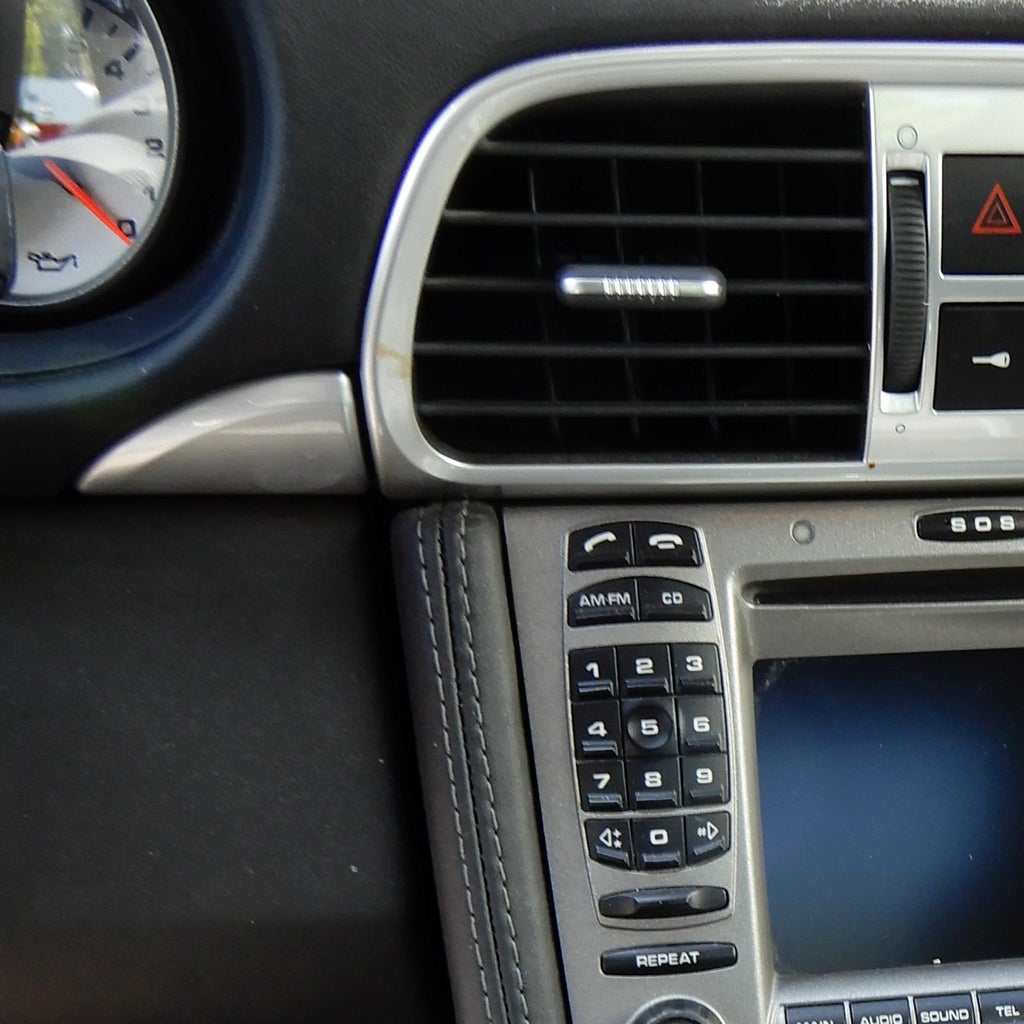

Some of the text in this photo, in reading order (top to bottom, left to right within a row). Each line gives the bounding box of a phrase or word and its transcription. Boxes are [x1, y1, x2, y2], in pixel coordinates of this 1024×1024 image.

[950, 515, 1015, 533] SOS
[661, 591, 684, 605] CD
[585, 662, 600, 678] 1
[635, 657, 654, 675] 2
[685, 655, 703, 672] 3
[587, 721, 607, 737] 4
[640, 718, 659, 736] 5
[692, 716, 711, 733] 6
[592, 773, 611, 790] 7
[643, 771, 663, 788] 8
[695, 767, 713, 784] 9
[635, 951, 700, 969] REPEAT
[920, 1008, 970, 1024] SOUND
[995, 1005, 1021, 1018] TEL
